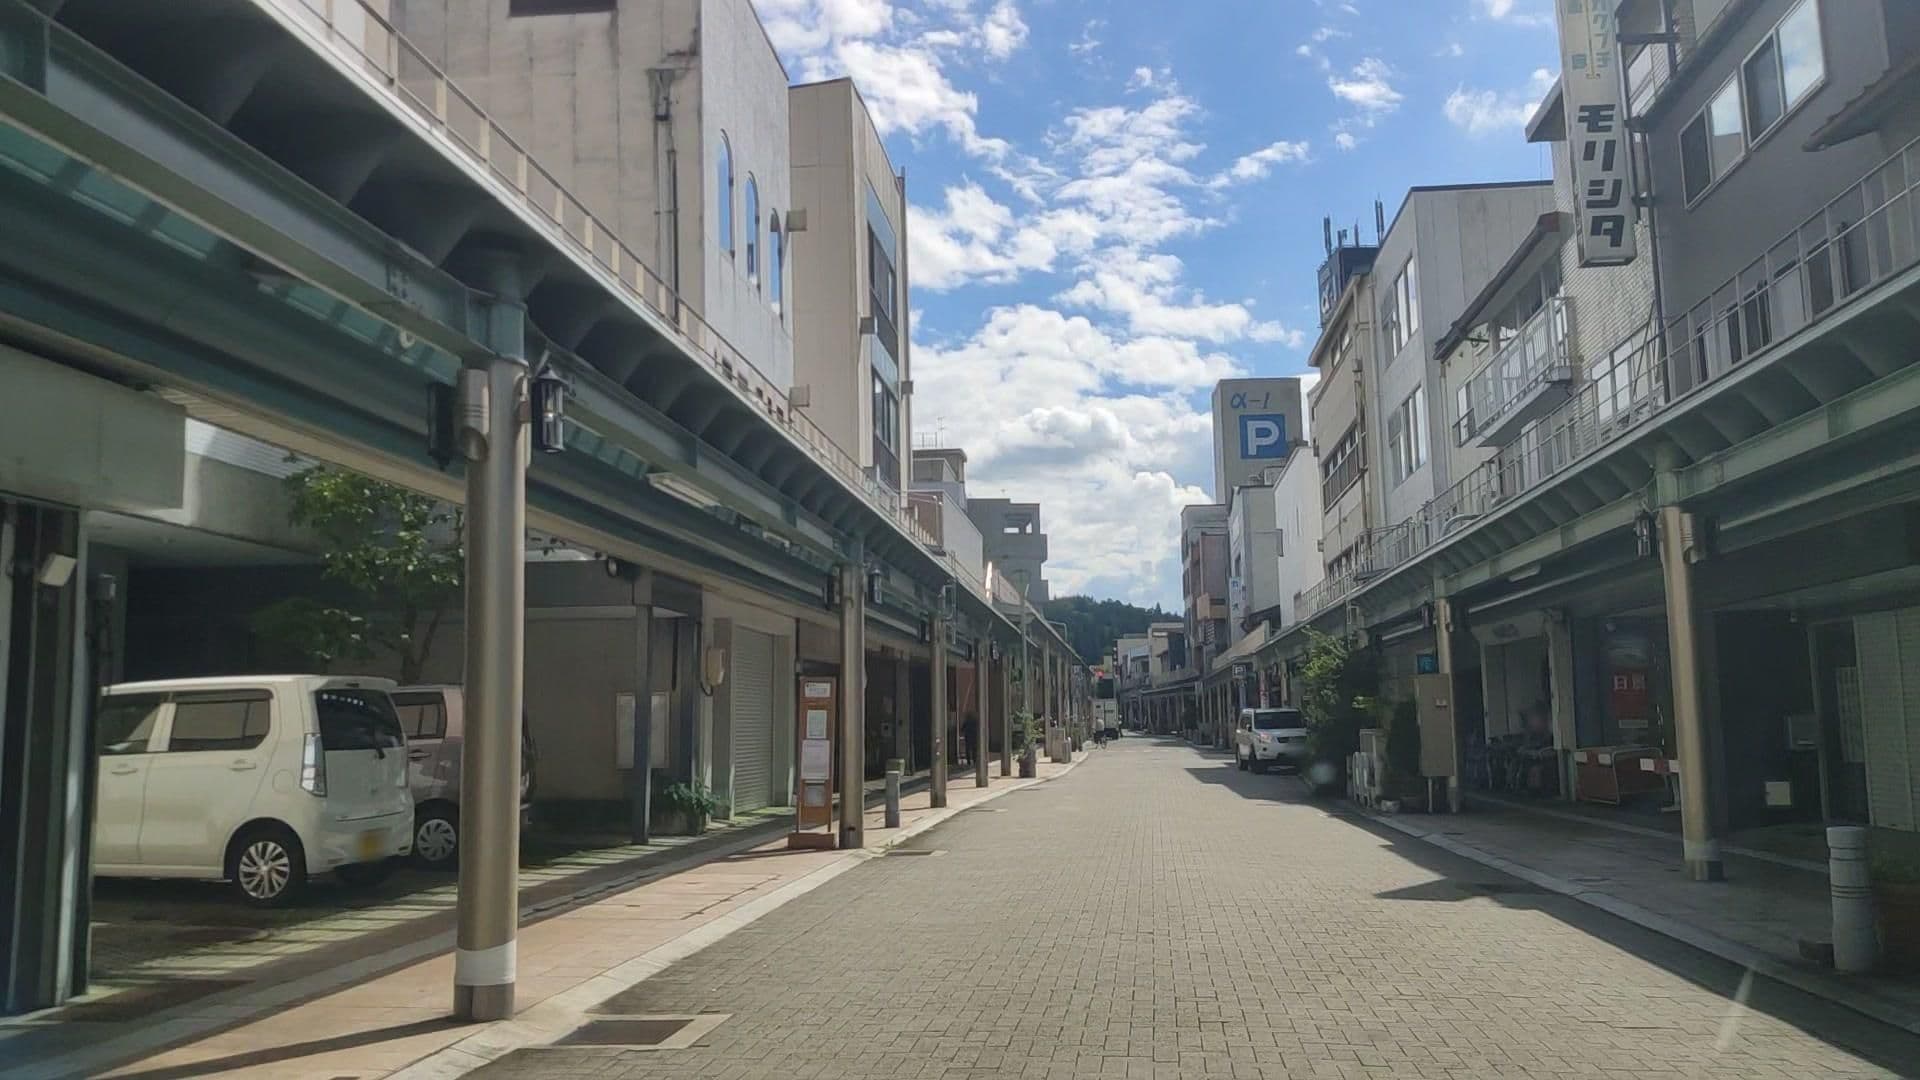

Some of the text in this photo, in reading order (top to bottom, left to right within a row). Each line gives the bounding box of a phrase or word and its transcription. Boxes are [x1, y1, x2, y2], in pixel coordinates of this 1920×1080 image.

[1577, 104, 1625, 248] モリシタ
[1247, 420, 1279, 456] P
